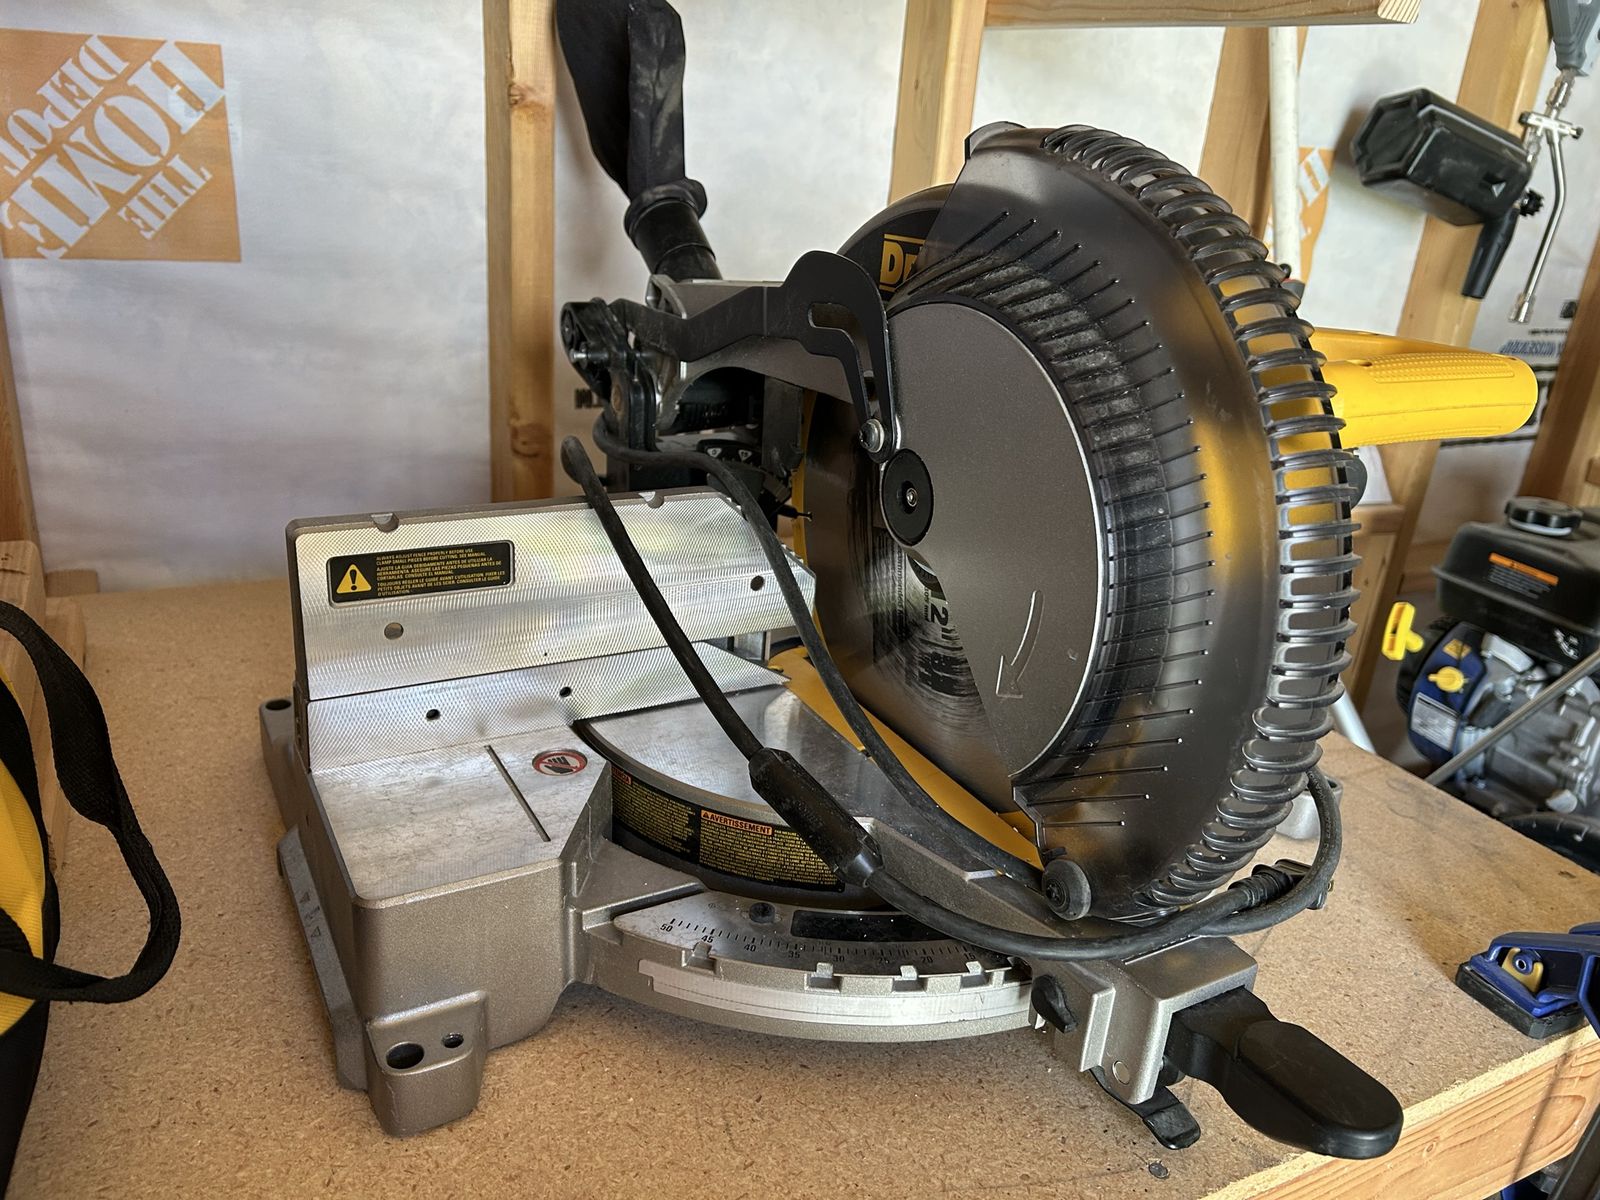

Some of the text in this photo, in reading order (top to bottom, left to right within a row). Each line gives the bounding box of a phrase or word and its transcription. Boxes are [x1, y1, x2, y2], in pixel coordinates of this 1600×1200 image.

[0, 40, 226, 259] HOME
[117, 154, 213, 240] THE
[710, 813, 771, 834] AVERTISSEMENT
[660, 923, 673, 933] 50
[701, 935, 714, 944] 45
[744, 944, 757, 953] 40
[788, 950, 801, 959] 35
[965, 952, 976, 960] 15
